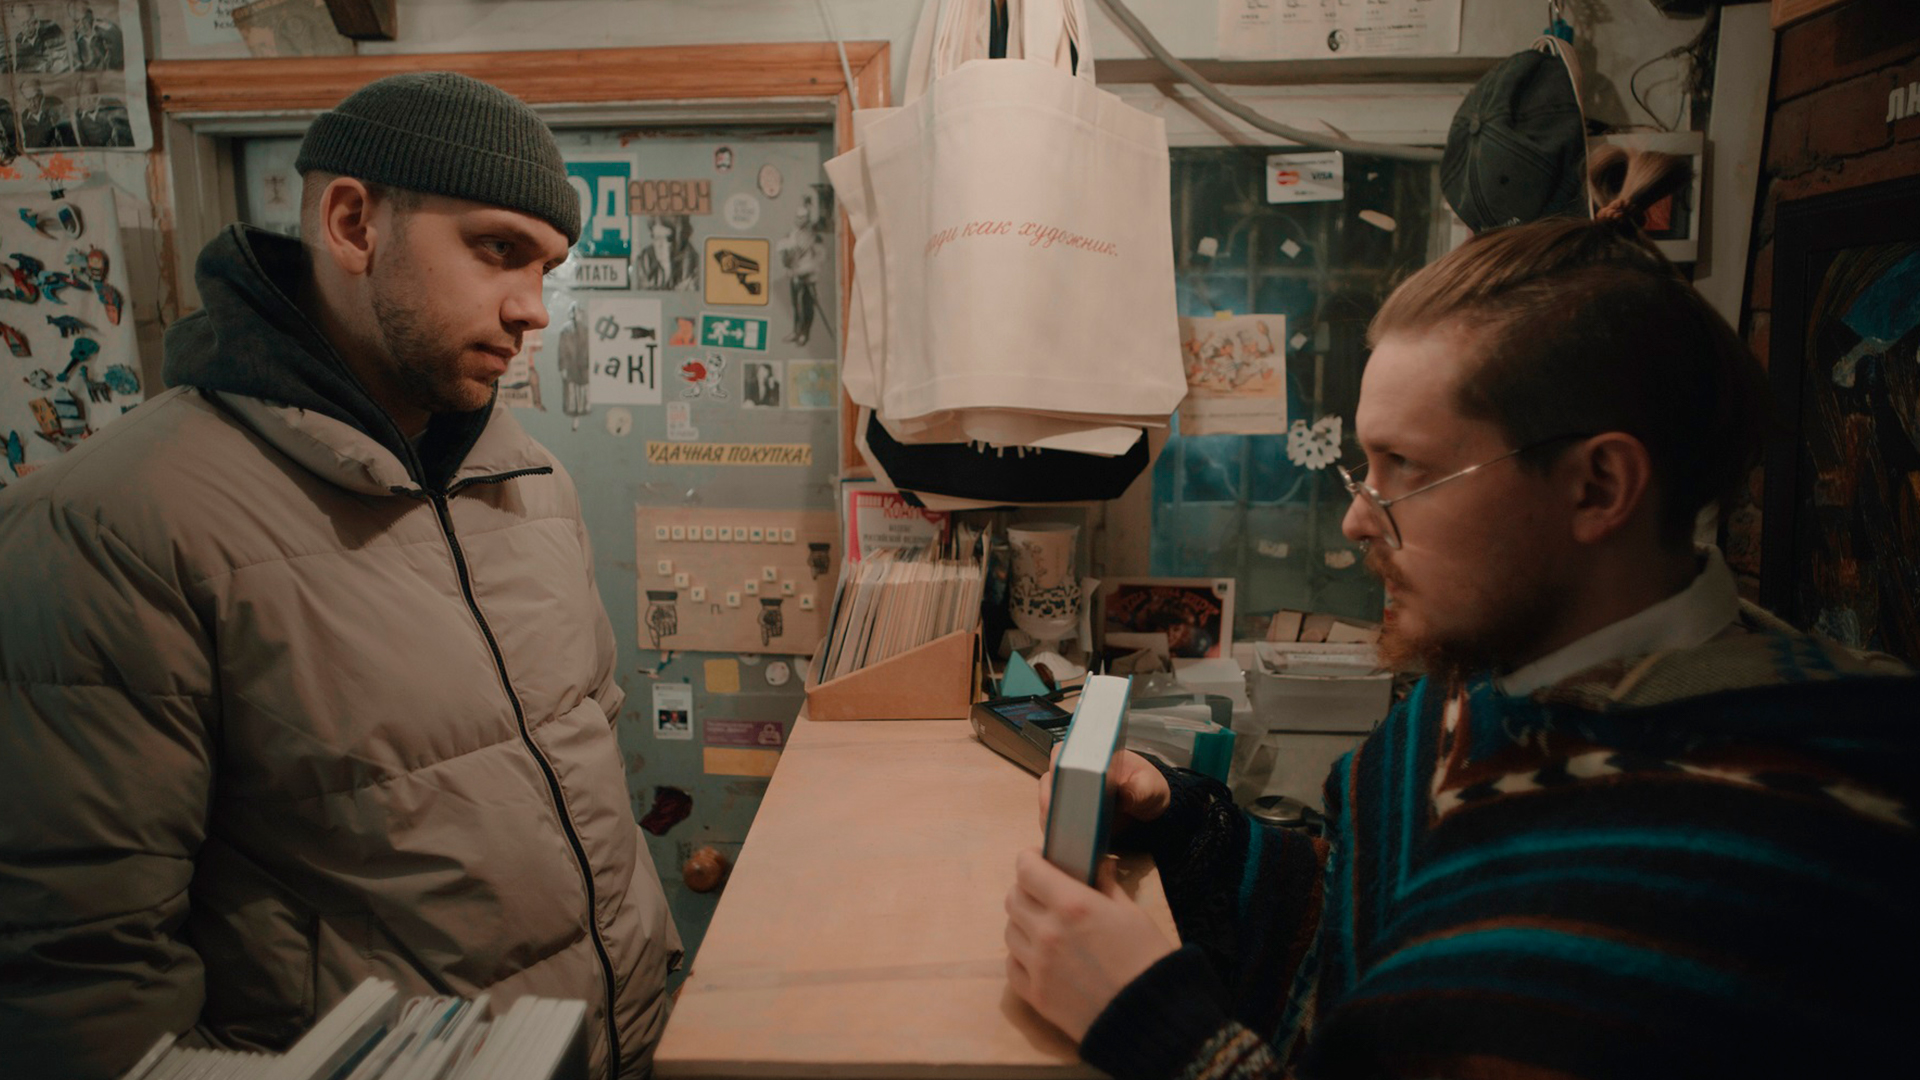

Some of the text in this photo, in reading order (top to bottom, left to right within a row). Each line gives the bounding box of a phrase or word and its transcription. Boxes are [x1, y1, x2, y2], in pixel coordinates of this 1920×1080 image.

[1311, 171, 1333, 181] VISA
[961, 219, 1012, 238] как
[1018, 220, 1119, 257] художник.
[649, 444, 812, 464] УДАЧНАЯ ПОКУПКА!
